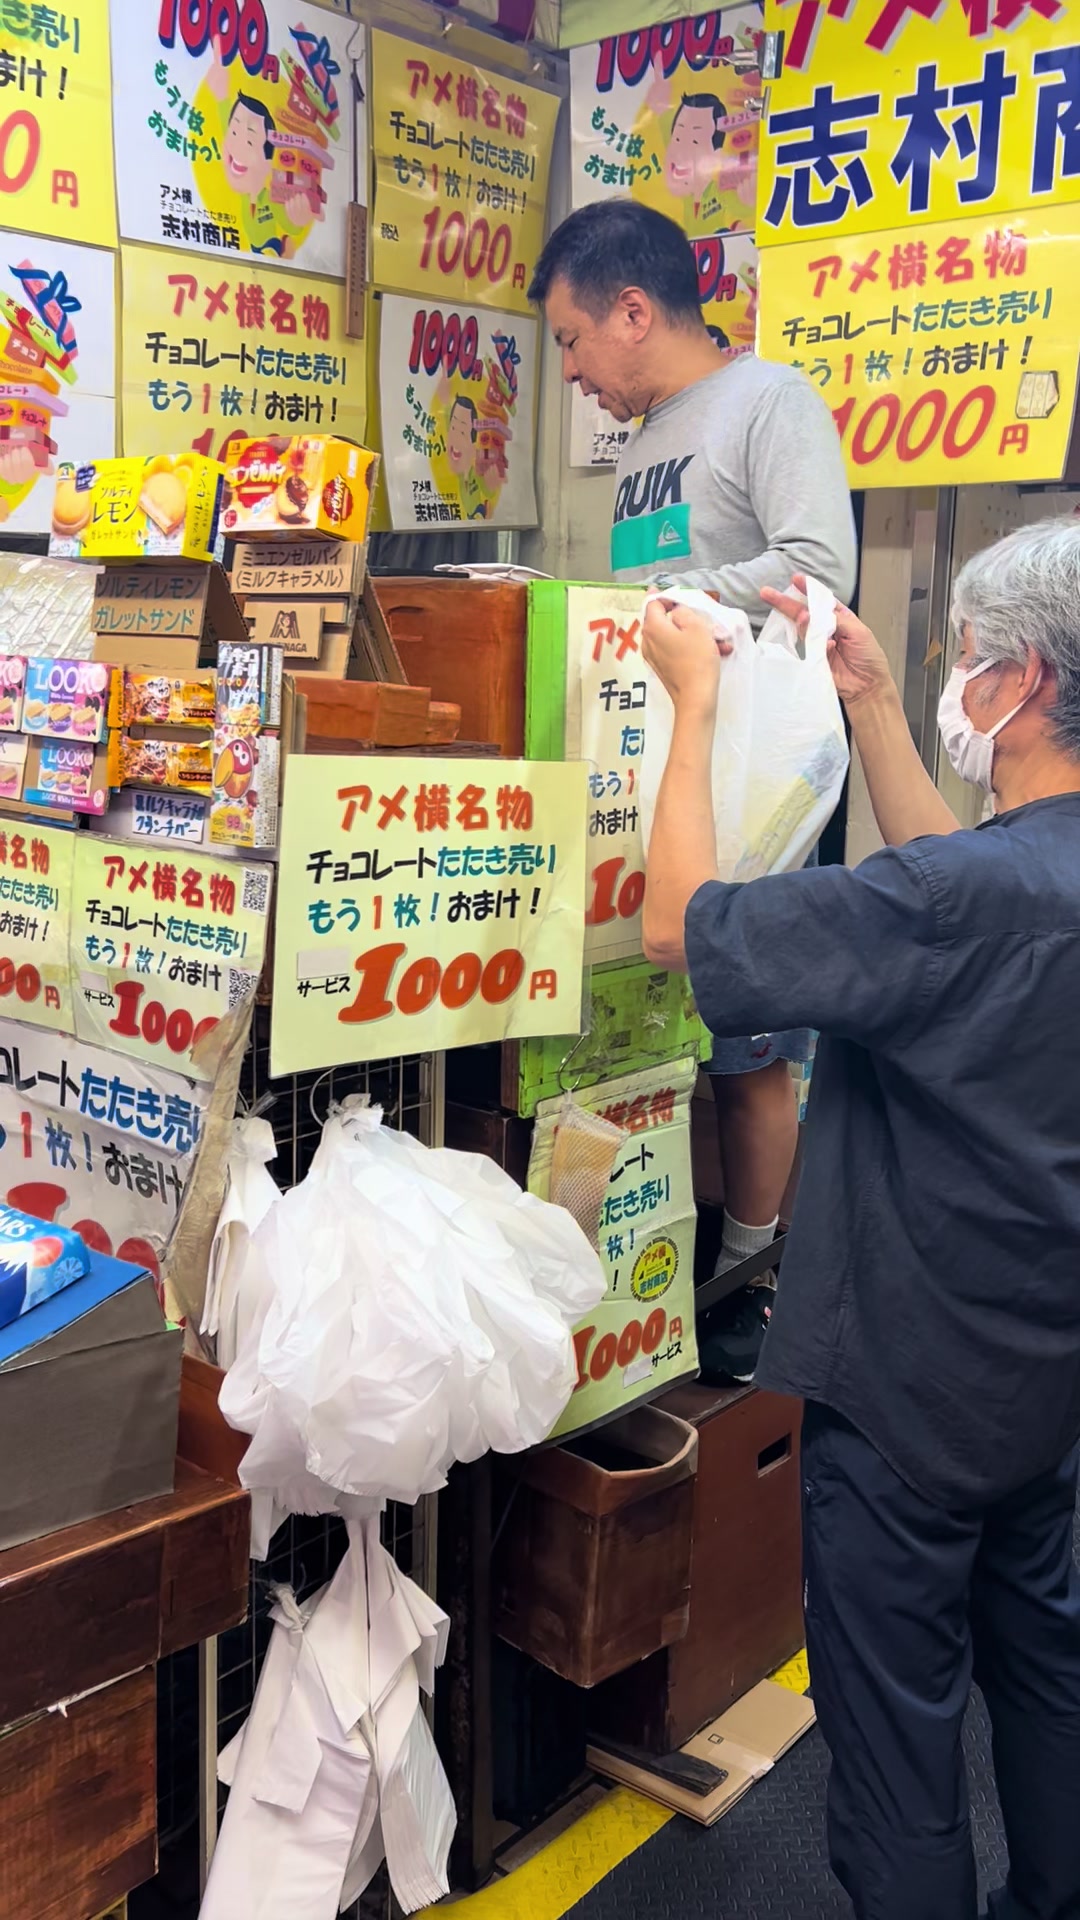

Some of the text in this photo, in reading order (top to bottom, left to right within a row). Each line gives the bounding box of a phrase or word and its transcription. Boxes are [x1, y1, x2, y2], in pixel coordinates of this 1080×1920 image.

[406, 59, 528, 139] アメ横名物
[390, 111, 536, 182] チョコレートたたき売り
[161, 214, 240, 250] 志村商店
[419, 206, 526, 289] 1000円
[808, 229, 1028, 298] アメ横名物
[168, 274, 330, 341] アメ横名物
[782, 288, 1053, 347] チョコレートたたき売り
[11, 338, 39, 361] チョコ
[145, 331, 347, 385] チョコレートたたき売り
[408, 310, 484, 382] 1000円
[92, 501, 140, 523] レモン
[613, 453, 696, 524] QUIK
[242, 547, 342, 567] ミニエンゼルパイ
[94, 606, 195, 632] ガレットサンド
[34, 662, 93, 695] LOOK
[337, 783, 534, 832] アメ横名物
[588, 806, 639, 838] おまけ
[104, 855, 236, 916] アメ横名物
[306, 843, 556, 884] チョコレートたたき売り
[1, 911, 49, 942] おまけ！
[85, 899, 248, 958] チョコレートたたき売り
[308, 887, 541, 934] もう1枚！おまけ！
[84, 990, 115, 1008] サービス
[297, 942, 557, 1025] サービス 1000円
[652, 1341, 683, 1367] サービス
